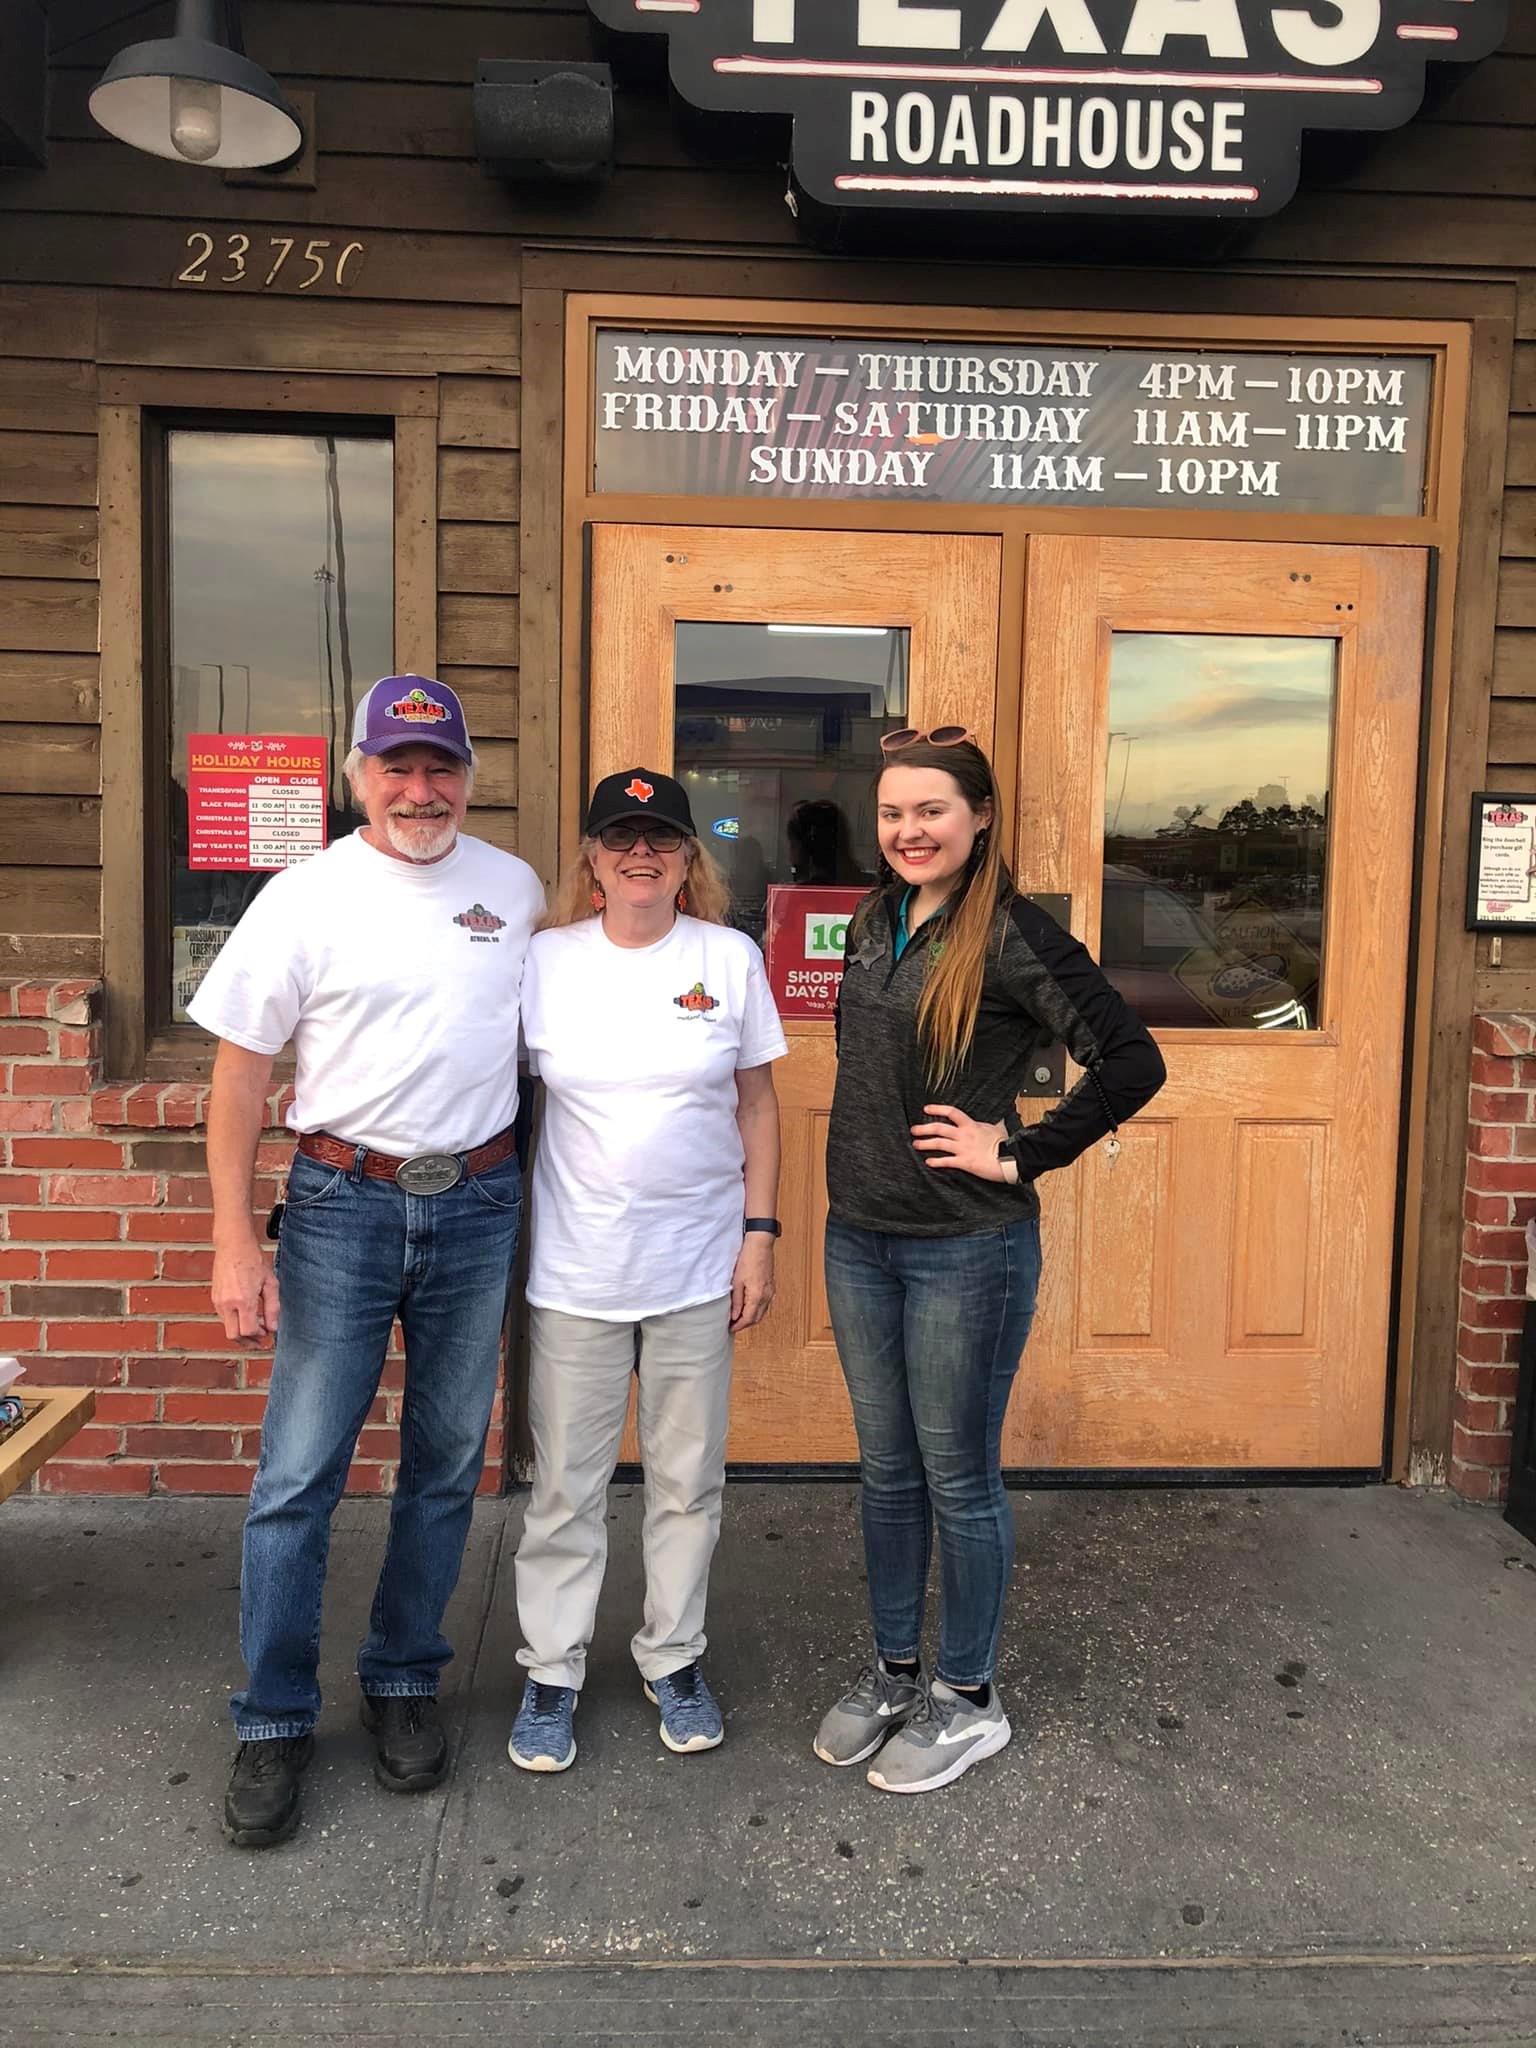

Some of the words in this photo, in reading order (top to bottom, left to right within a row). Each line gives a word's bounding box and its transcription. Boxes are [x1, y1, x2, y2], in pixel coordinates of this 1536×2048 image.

[850, 91, 1246, 172] ROADHOUSE
[614, 346, 805, 388] MONDAY
[858, 353, 1099, 397] THURSDAY
[1139, 363, 1237, 401] 4PM
[1287, 367, 1405, 406] 10PM
[601, 392, 778, 434] FRIDAY
[833, 402, 1090, 443] SATURDAY
[1133, 409, 1250, 448] 11AM
[1295, 414, 1409, 453] 11PM
[749, 446, 935, 487] SUNDAY
[989, 453, 1105, 492] 11AM
[1157, 458, 1281, 496] 10PM
[395, 702, 444, 718] TEXAS
[192, 754, 260, 767] HOLIDAY
[267, 757, 322, 769] HOURS
[254, 776, 280, 784] OPEN
[290, 777, 319, 785] CLOSE
[1489, 811, 1521, 822] TEXAS
[785, 985, 829, 998] DAYS
